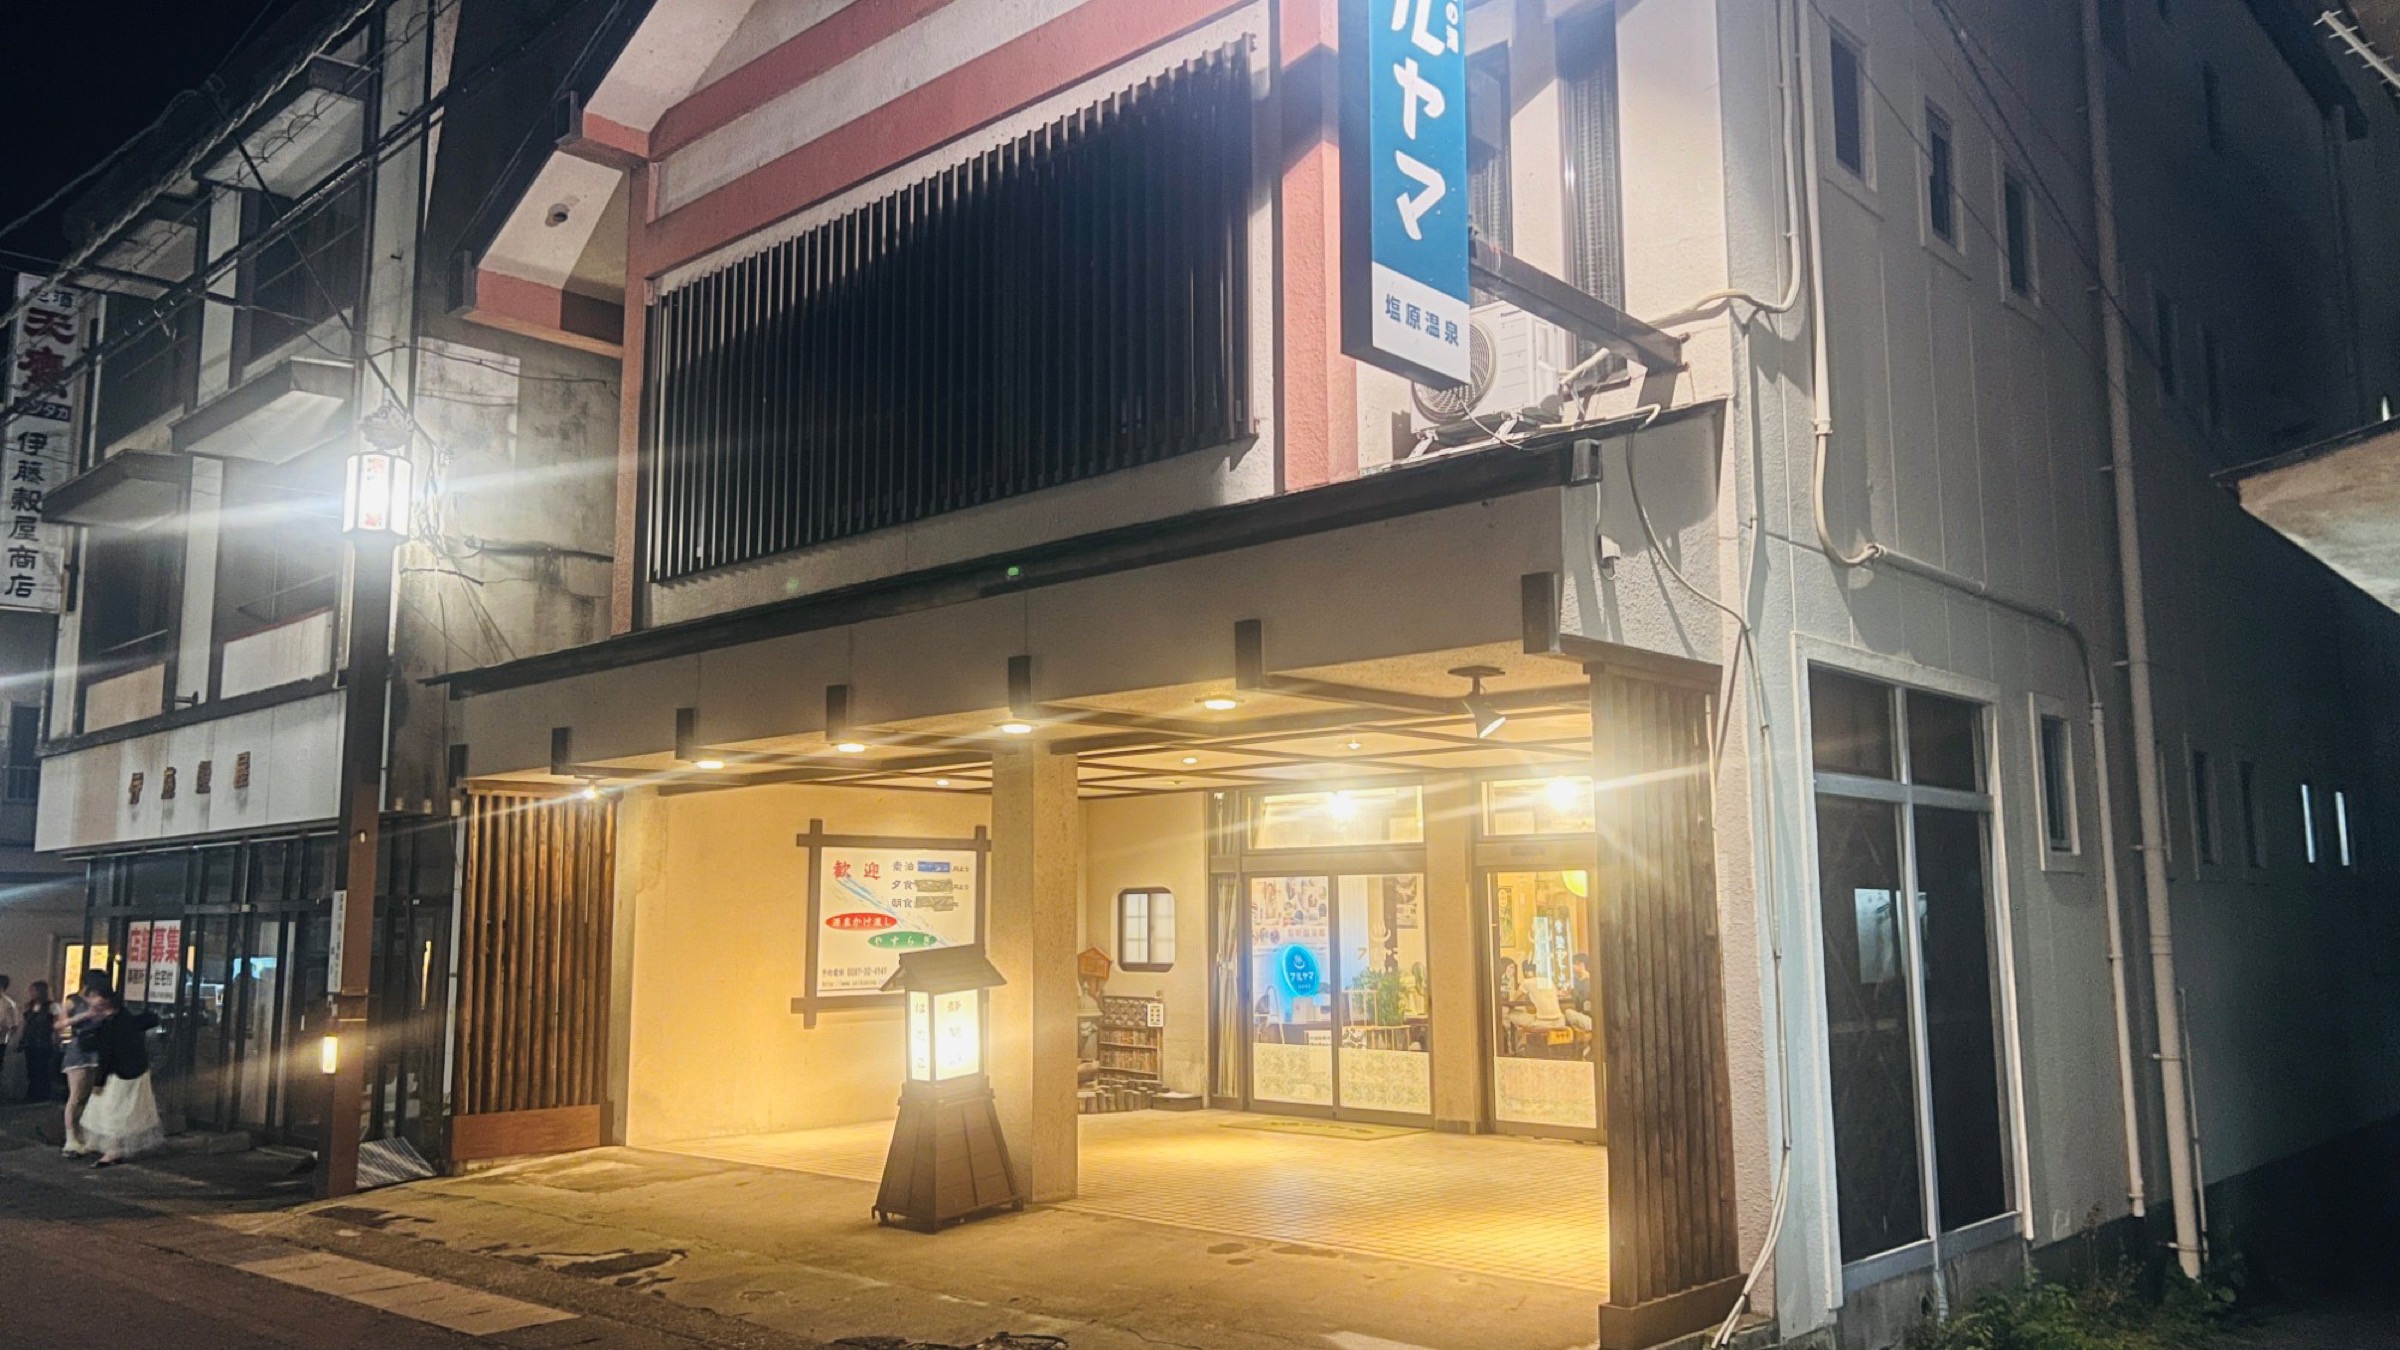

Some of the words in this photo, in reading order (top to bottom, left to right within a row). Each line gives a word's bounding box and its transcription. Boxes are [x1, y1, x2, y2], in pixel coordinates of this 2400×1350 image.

[1384, 293, 1459, 347] 塩原温泉
[4, 431, 48, 599] 伊藤穀屋商店
[891, 880, 913, 890] 夕食
[891, 898, 913, 908] 朝食
[1289, 971, 1314, 982] フルヤマ
